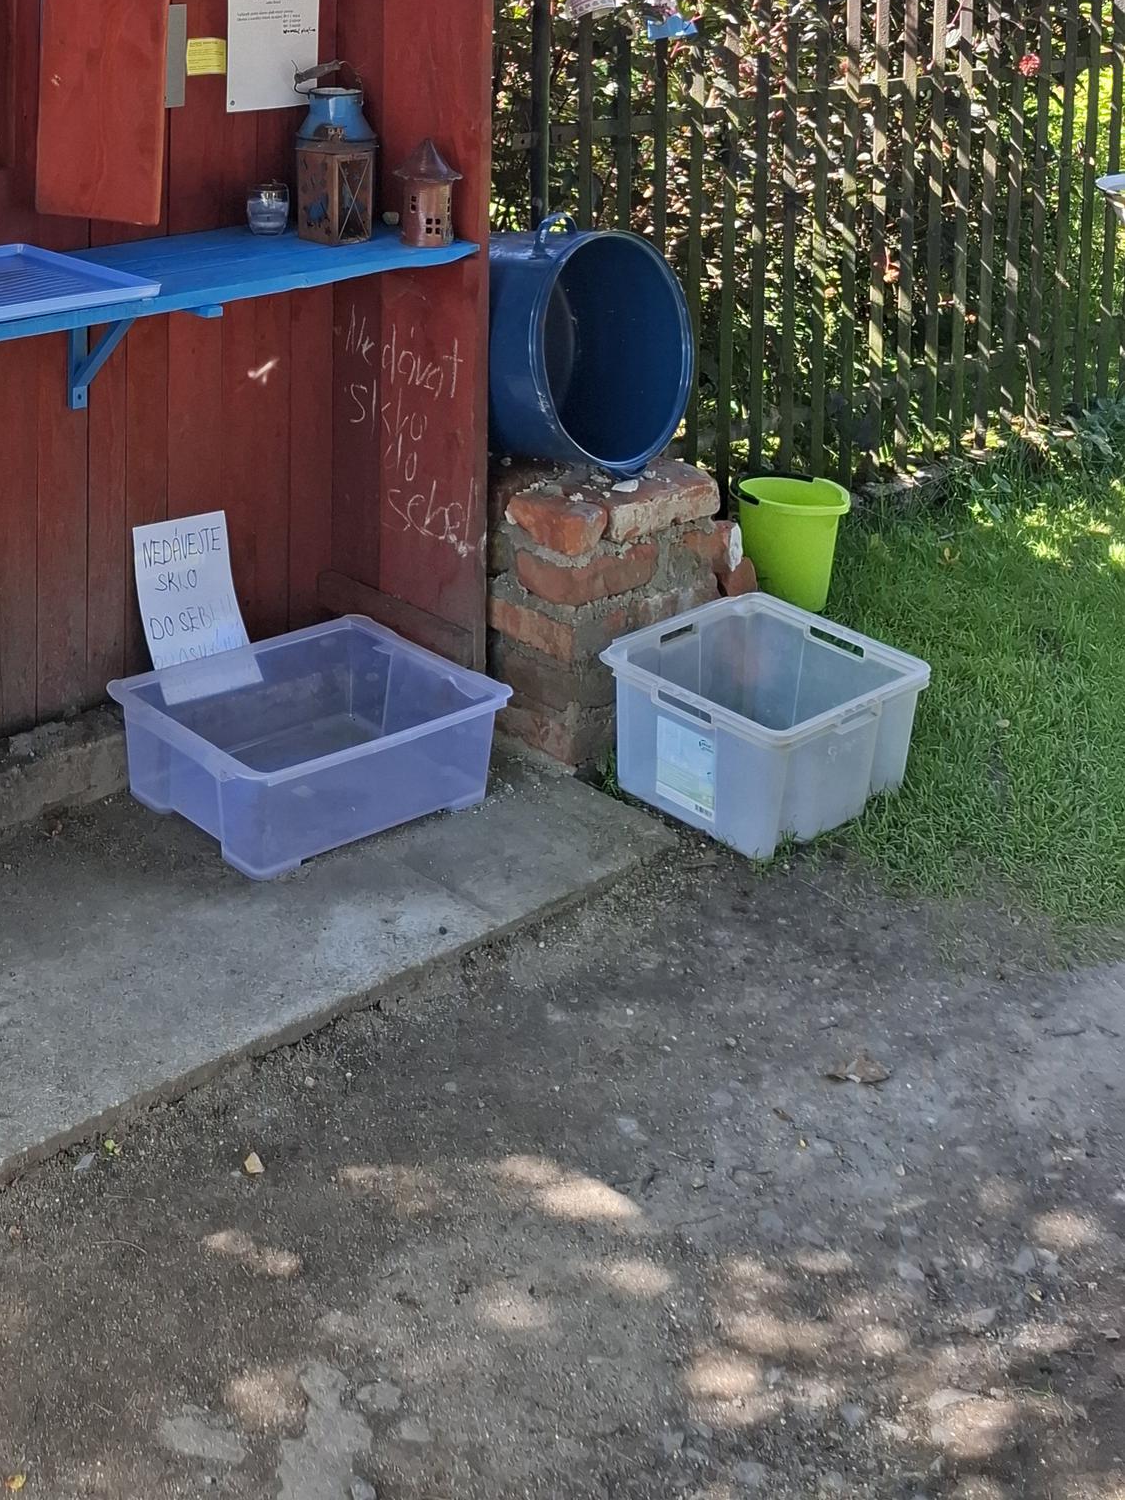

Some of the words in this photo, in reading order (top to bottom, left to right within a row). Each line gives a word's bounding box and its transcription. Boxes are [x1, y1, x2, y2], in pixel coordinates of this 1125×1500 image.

[142, 526, 222, 569] NEDÁVEJTE
[154, 568, 198, 593] SKLO
[149, 615, 175, 641] DO
